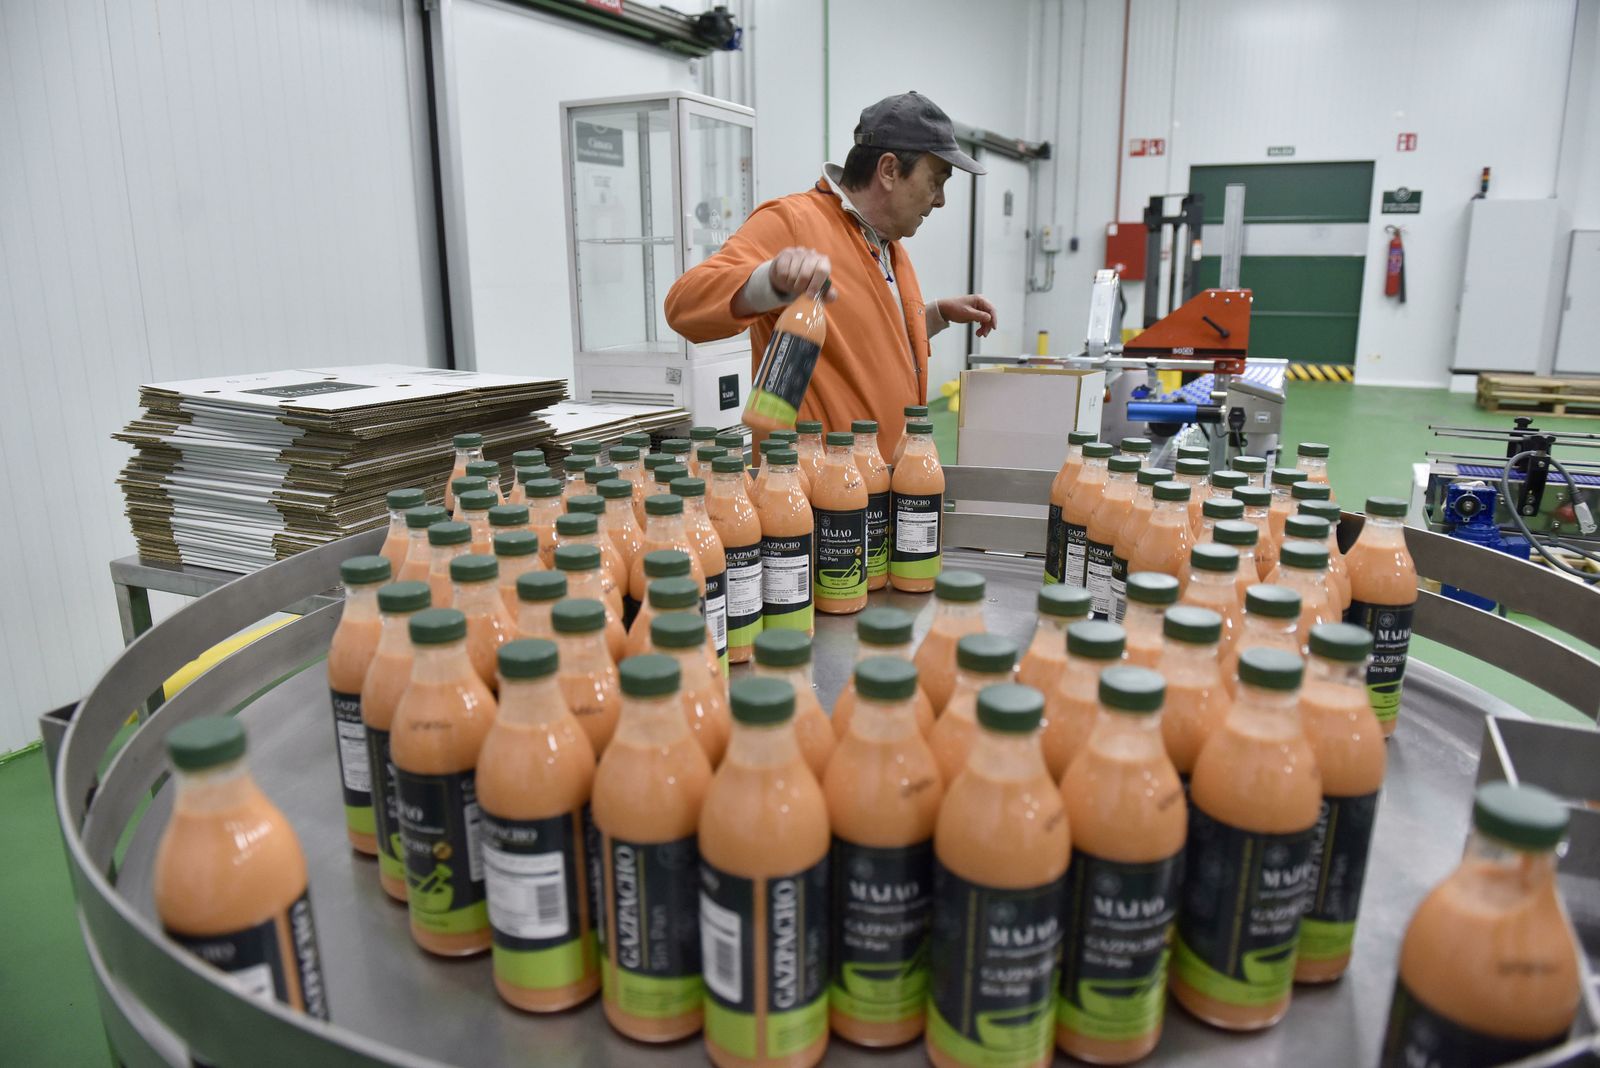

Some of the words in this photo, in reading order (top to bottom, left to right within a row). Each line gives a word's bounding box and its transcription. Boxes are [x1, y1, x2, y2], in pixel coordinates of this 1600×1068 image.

[897, 498, 931, 506] GAZPACHO
[821, 529, 852, 538] MAJAO
[762, 541, 801, 550] GAZPACHO
[820, 547, 854, 555] GAZPACHO
[615, 845, 640, 969] GAZPACHO
[773, 880, 797, 1008] GAZPACHO
